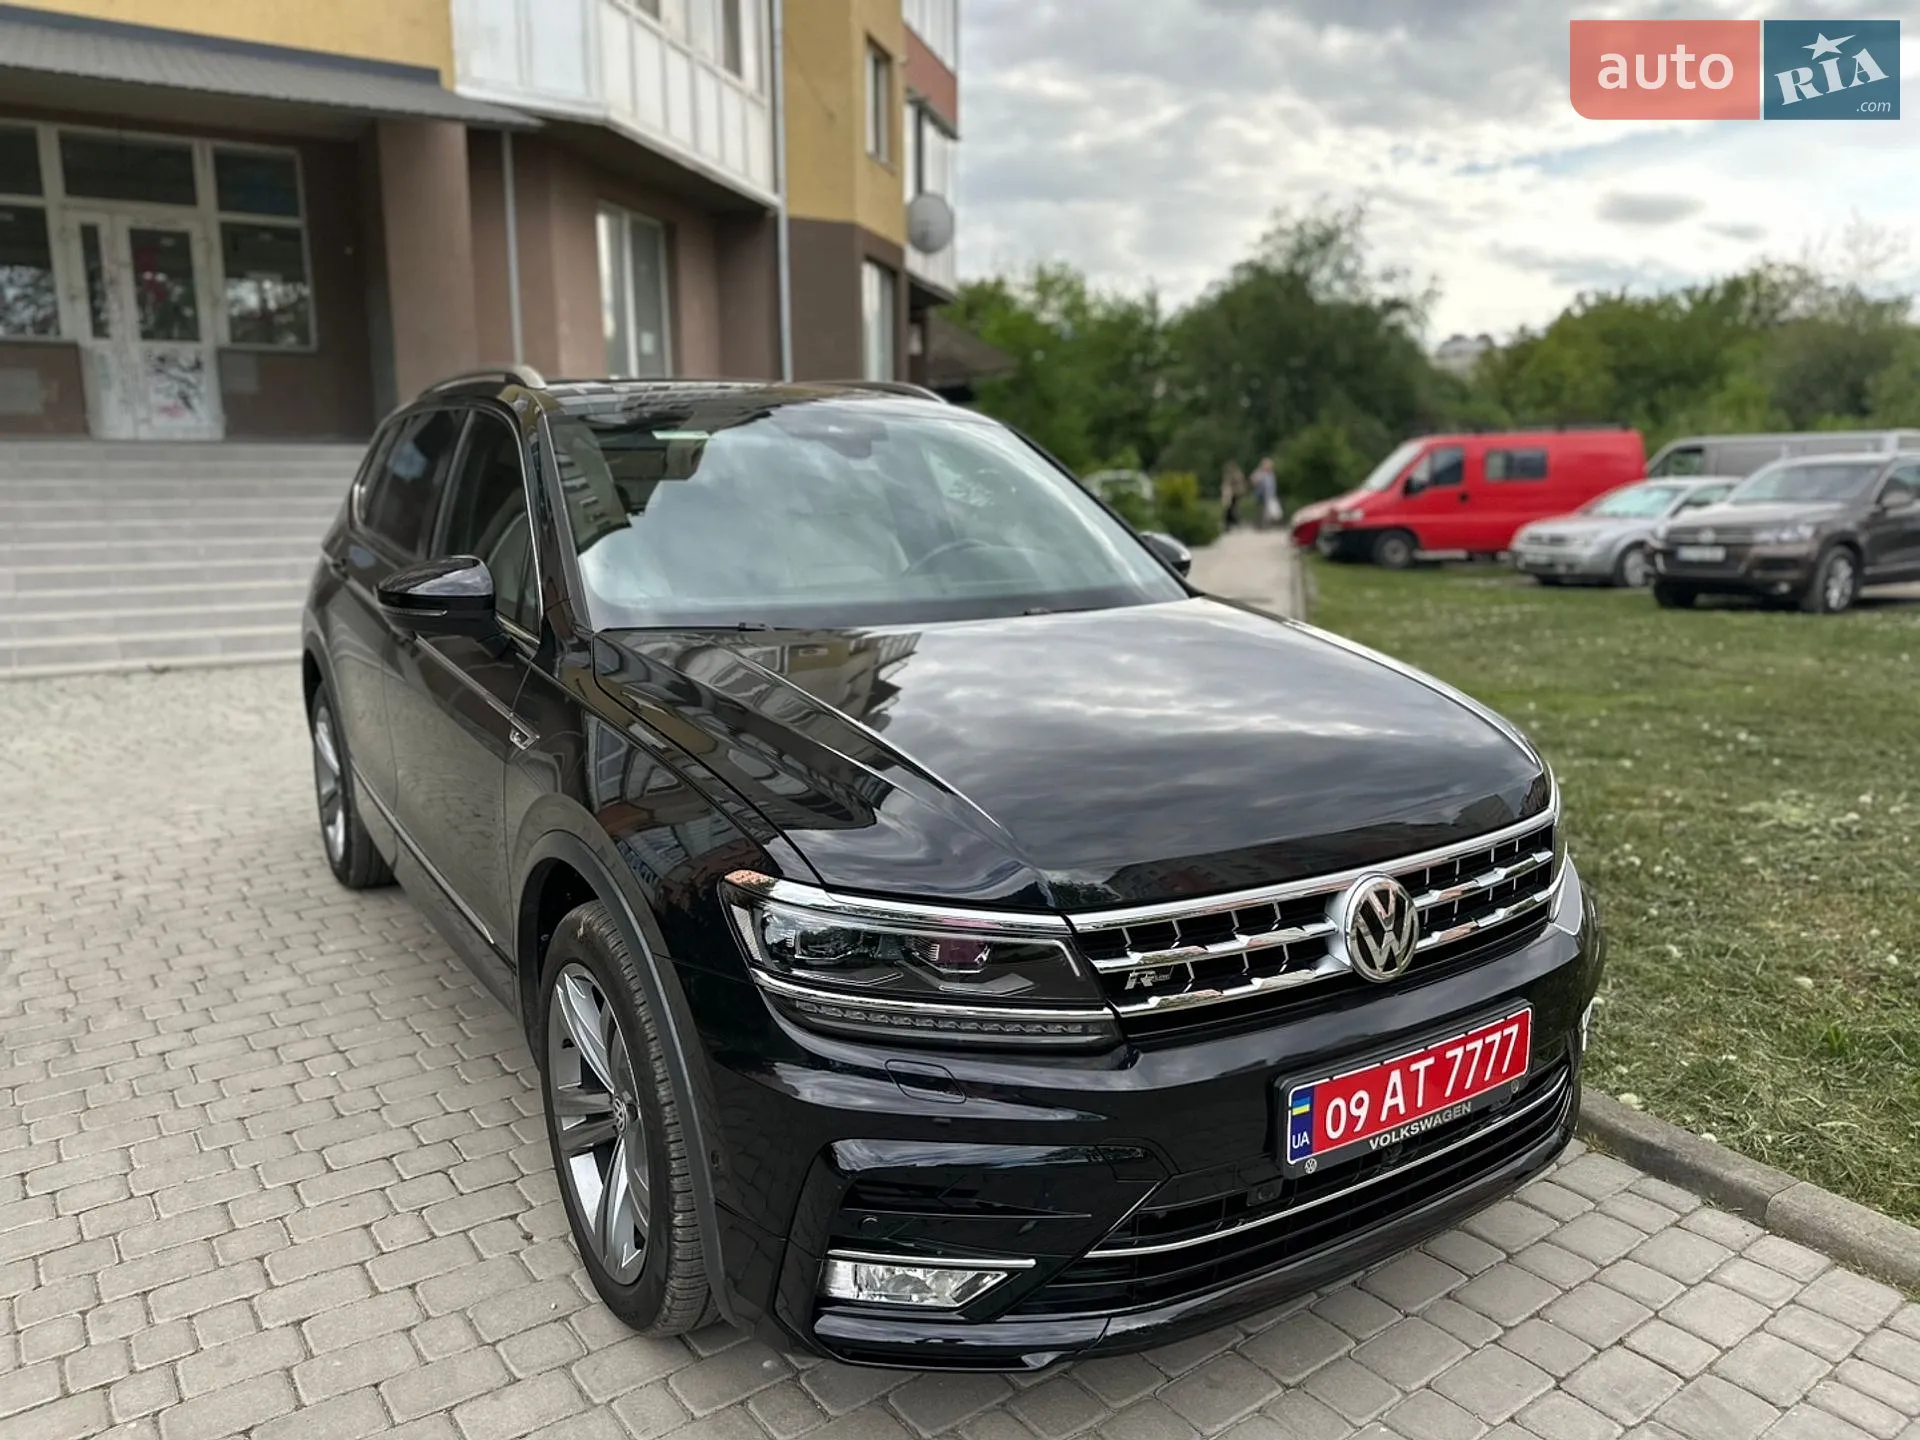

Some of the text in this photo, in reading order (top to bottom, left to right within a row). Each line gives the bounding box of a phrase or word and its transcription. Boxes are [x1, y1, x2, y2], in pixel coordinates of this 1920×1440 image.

[1325, 1023, 1520, 1140] 09 AT 7777
[1292, 1132, 1310, 1149] UA
[1369, 1102, 1472, 1151] VOLKSWAGEN
